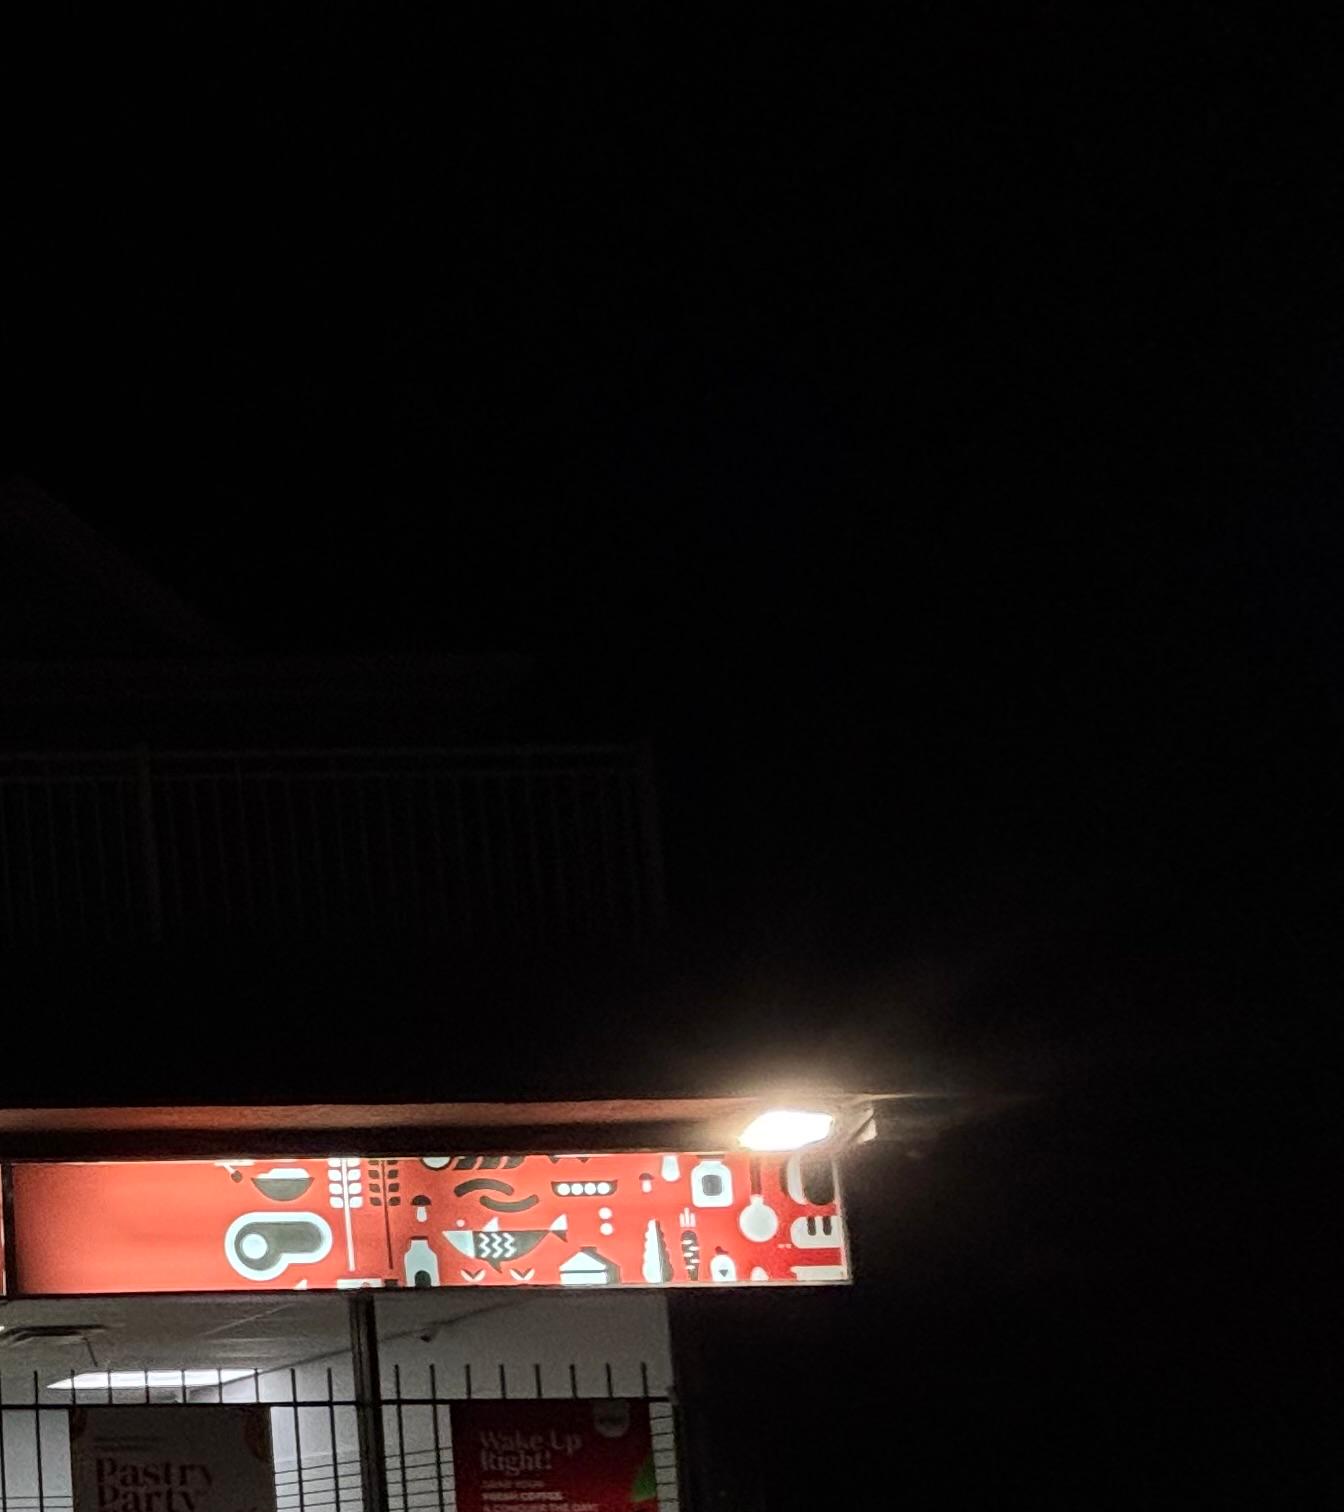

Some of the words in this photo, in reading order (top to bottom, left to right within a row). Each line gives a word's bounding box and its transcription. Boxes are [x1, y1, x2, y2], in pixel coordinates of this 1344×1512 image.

[479, 1428, 544, 1451] Wake
[549, 1428, 584, 1458] Up
[97, 1458, 214, 1492] Pastry
[479, 1449, 553, 1477] Right!
